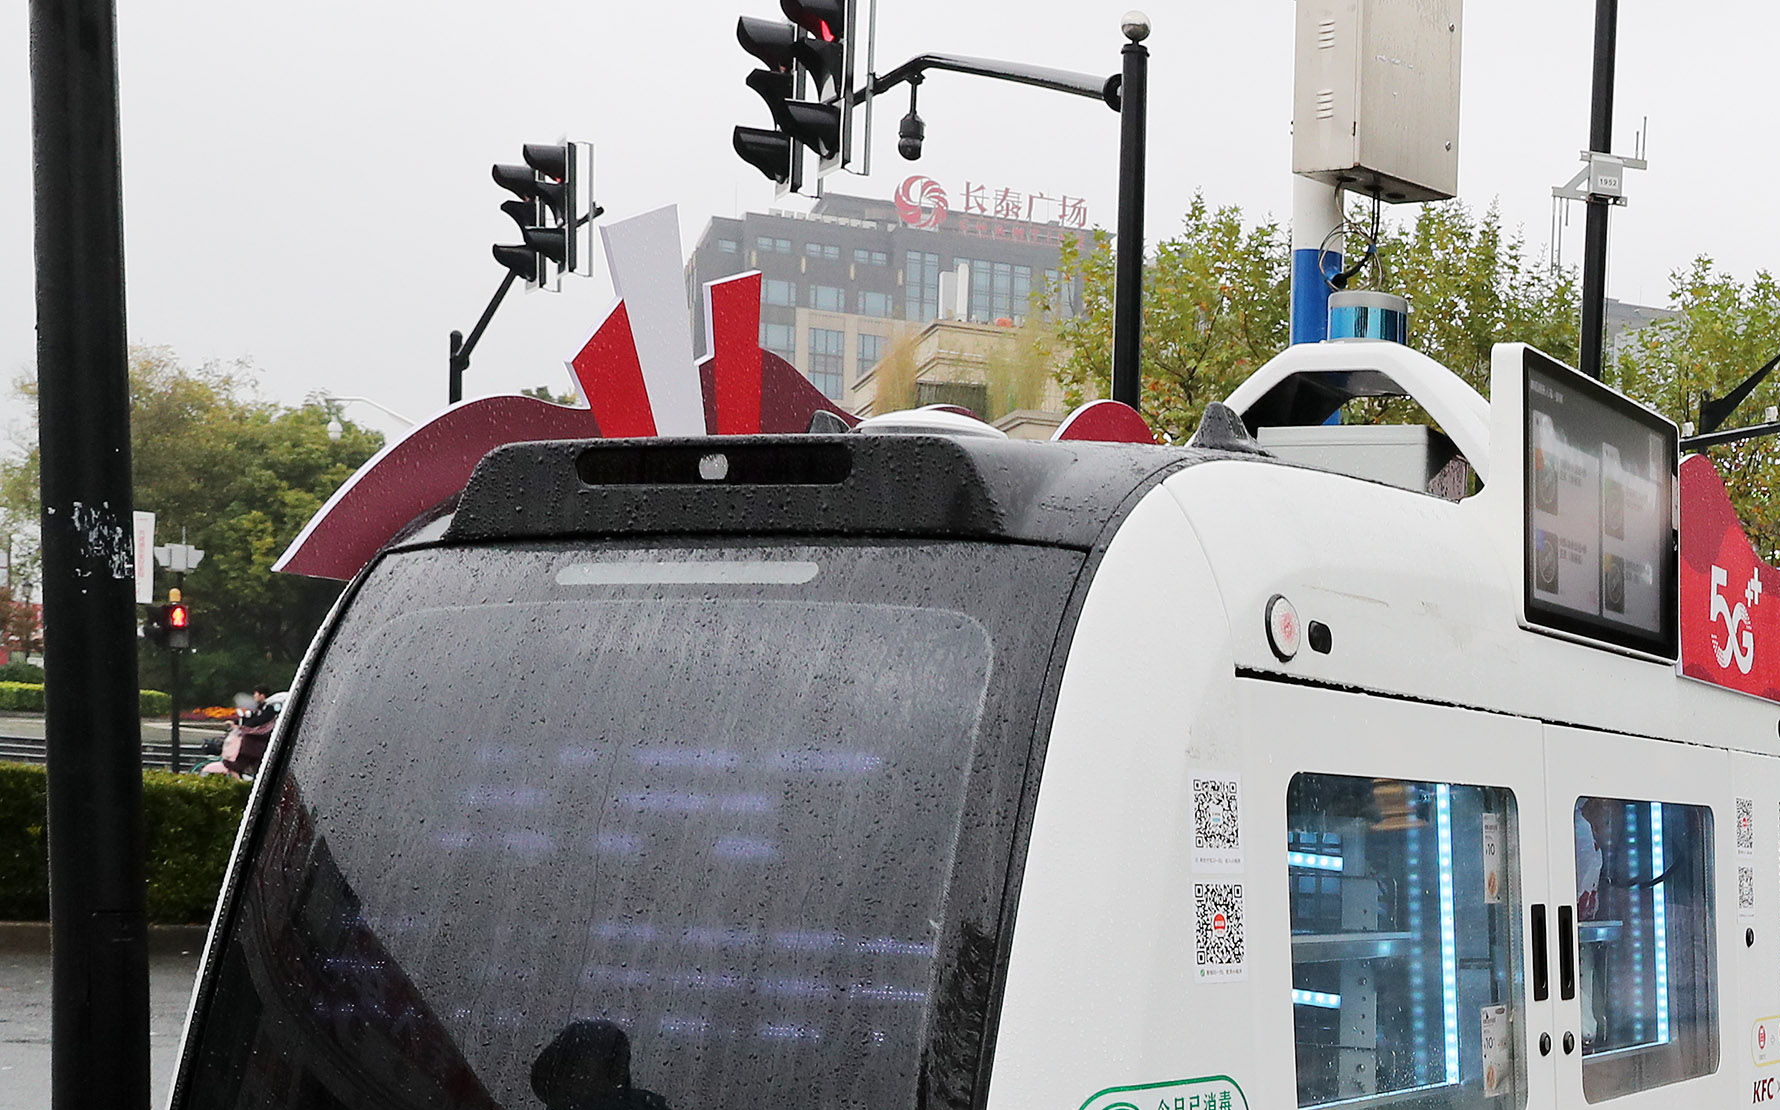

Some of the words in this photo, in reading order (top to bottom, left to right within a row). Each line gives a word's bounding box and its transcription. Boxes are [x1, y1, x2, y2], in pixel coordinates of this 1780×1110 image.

[1599, 178, 1617, 187] 1952
[959, 180, 1089, 228] 长泰广场
[1752, 1077, 1775, 1104] KFC
